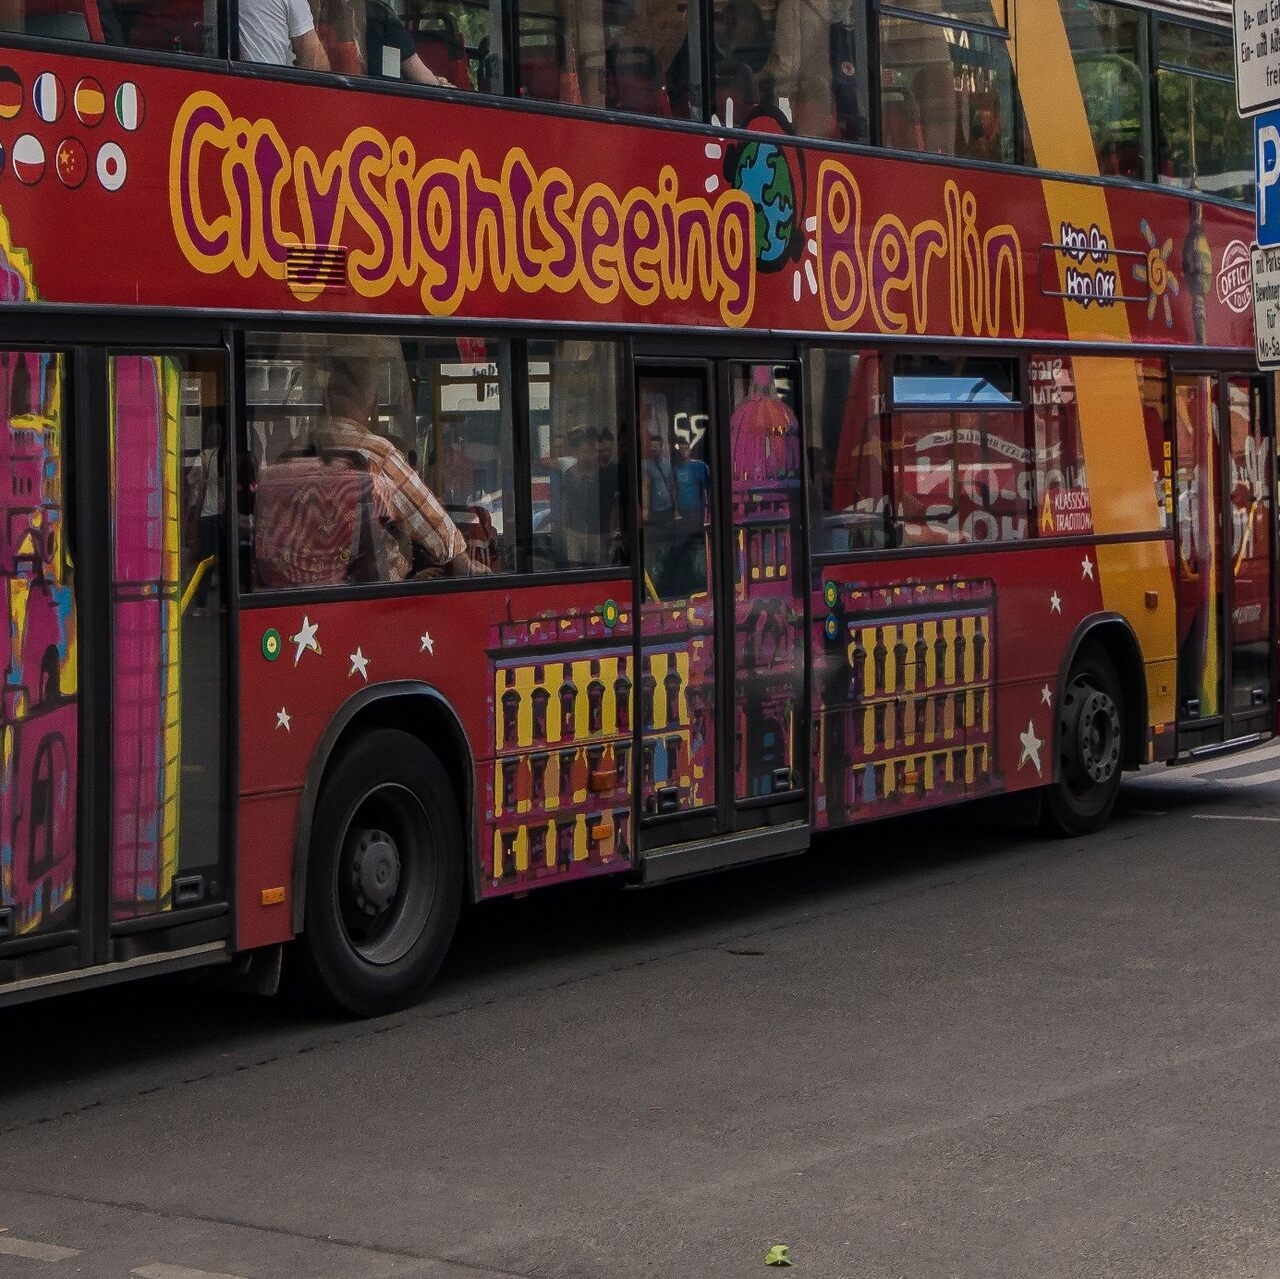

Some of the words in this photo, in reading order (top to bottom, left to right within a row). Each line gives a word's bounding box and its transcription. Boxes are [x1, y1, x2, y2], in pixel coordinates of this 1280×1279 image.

[1243, 9, 1254, 32] Be-
[1257, 3, 1269, 24] und
[1241, 39, 1254, 64] Ein-
[1257, 33, 1268, 58] und
[1266, 62, 1280, 88] frei
[169, 90, 756, 329] CitySightseeing
[816, 159, 1024, 338] Berlin
[1062, 223, 1087, 261] Hop
[1090, 226, 1107, 260] On
[1067, 271, 1092, 305] Hop
[1096, 272, 1115, 303] Off
[1266, 308, 1277, 330] für
[1259, 337, 1280, 358] Mo-Sa
